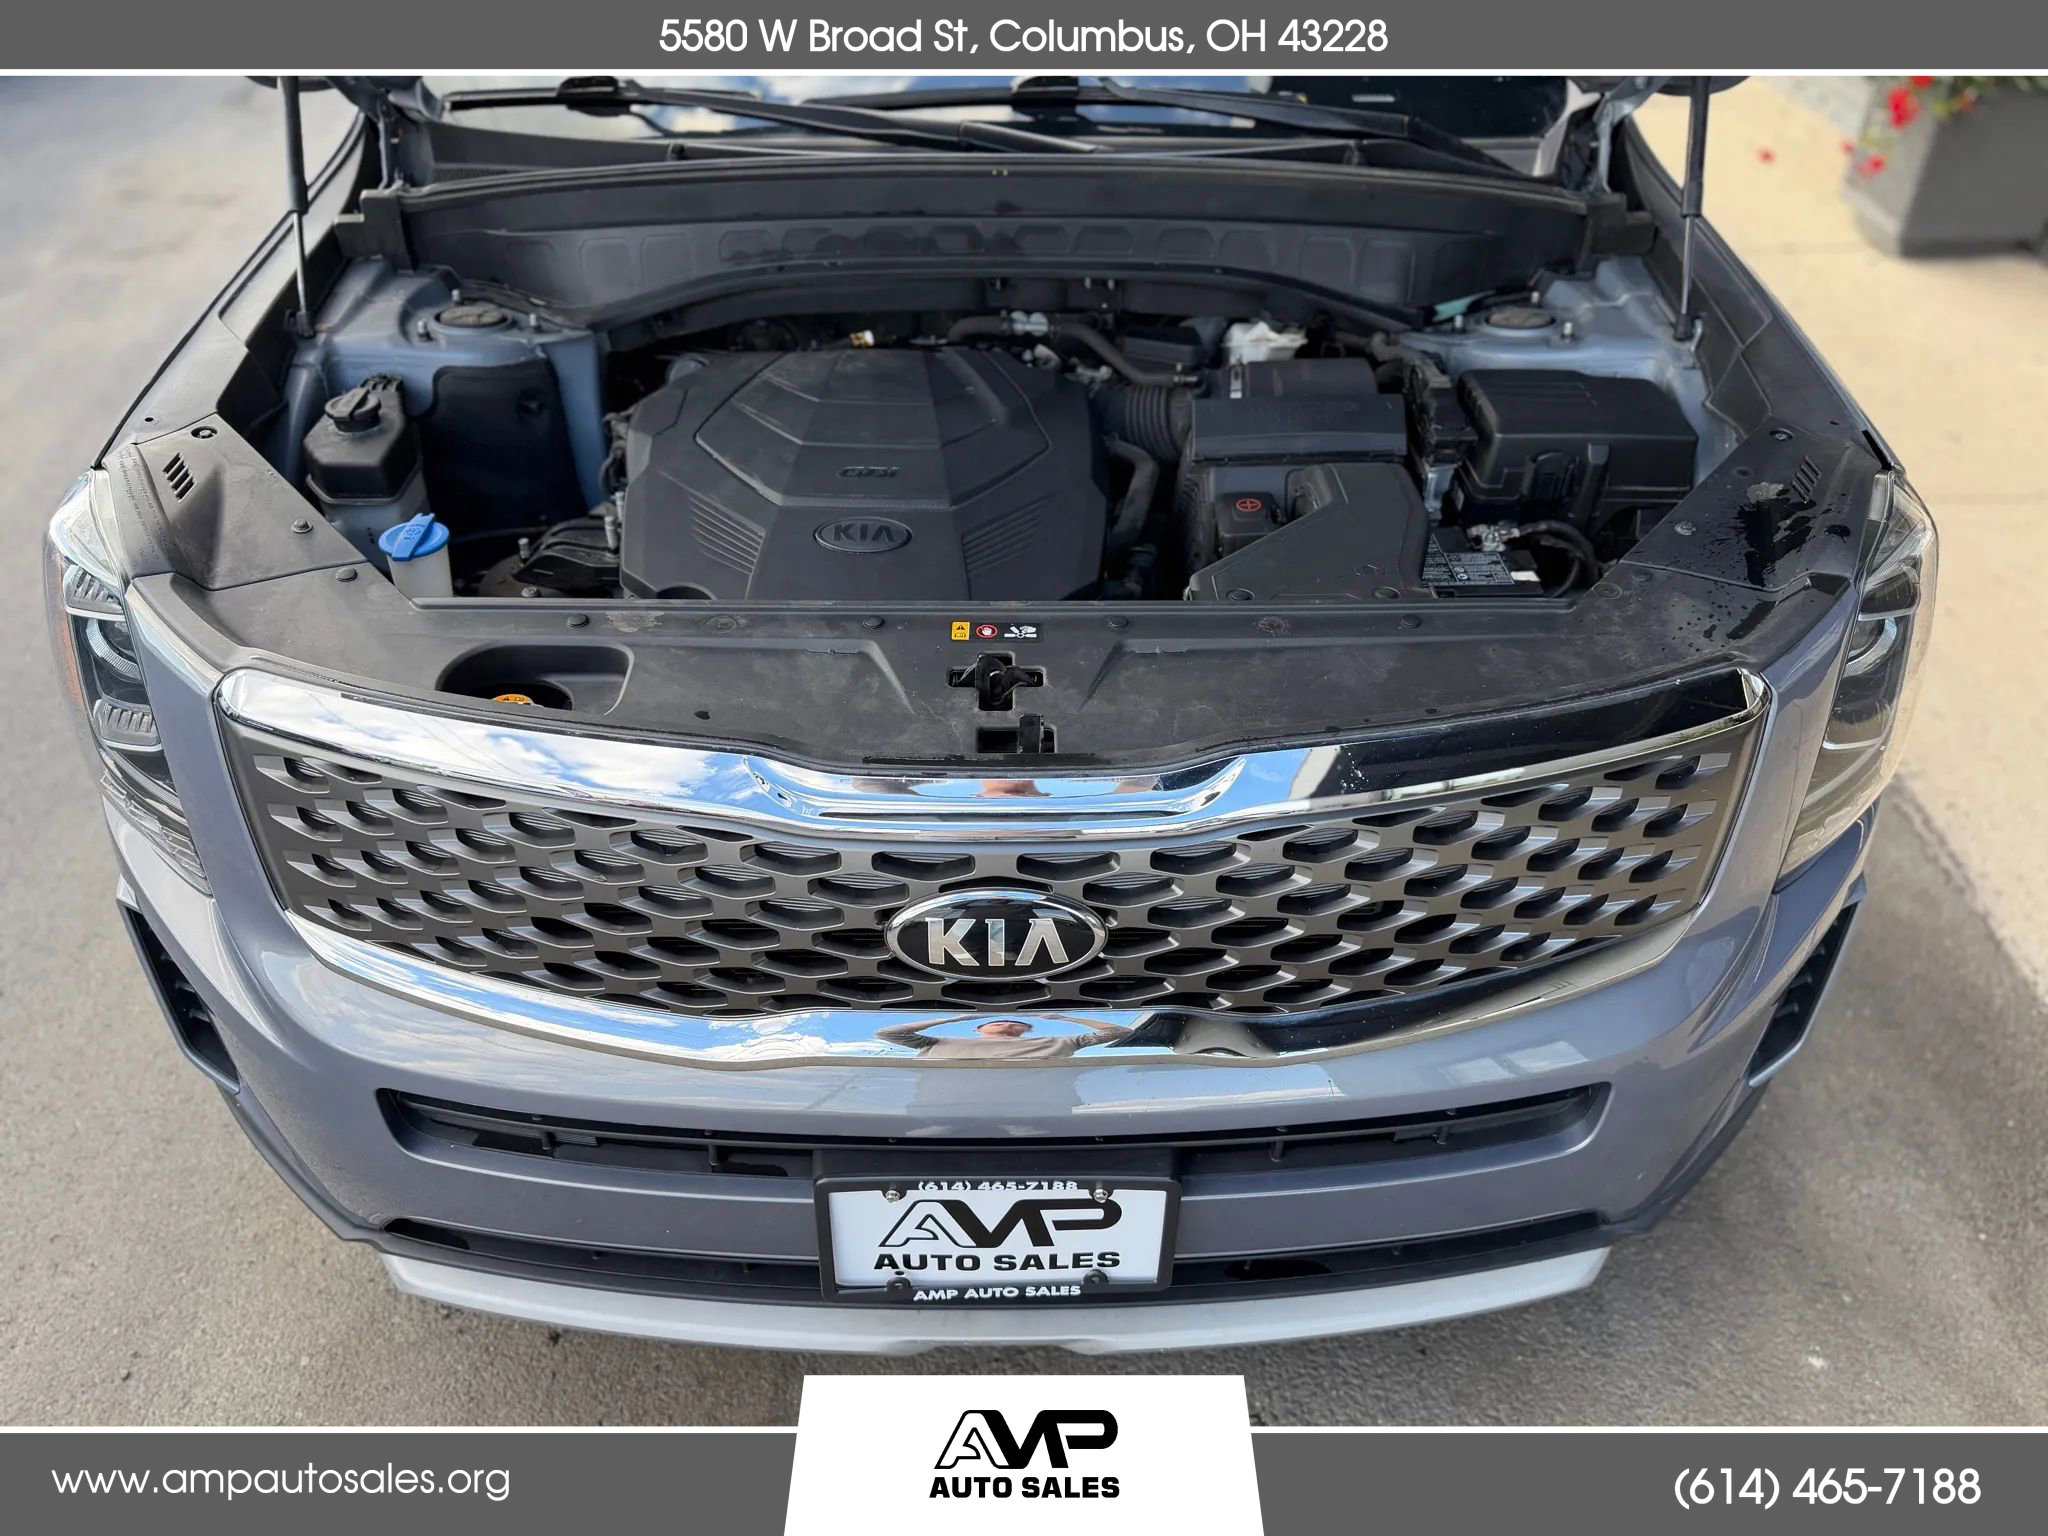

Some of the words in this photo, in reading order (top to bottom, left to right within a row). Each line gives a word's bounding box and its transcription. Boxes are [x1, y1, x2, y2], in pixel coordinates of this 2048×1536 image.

[833, 523, 895, 542] KIA
[925, 918, 1069, 967] KIA
[918, 1180, 972, 1191] (614)
[977, 1180, 1079, 1192] 465-7188
[878, 1198, 1123, 1249] AMP
[873, 1253, 982, 1272] AUTO
[993, 1251, 1121, 1272] SALES
[913, 1288, 959, 1302] AMP
[963, 1287, 1020, 1300] AUTO
[1024, 1284, 1082, 1298] SALES
